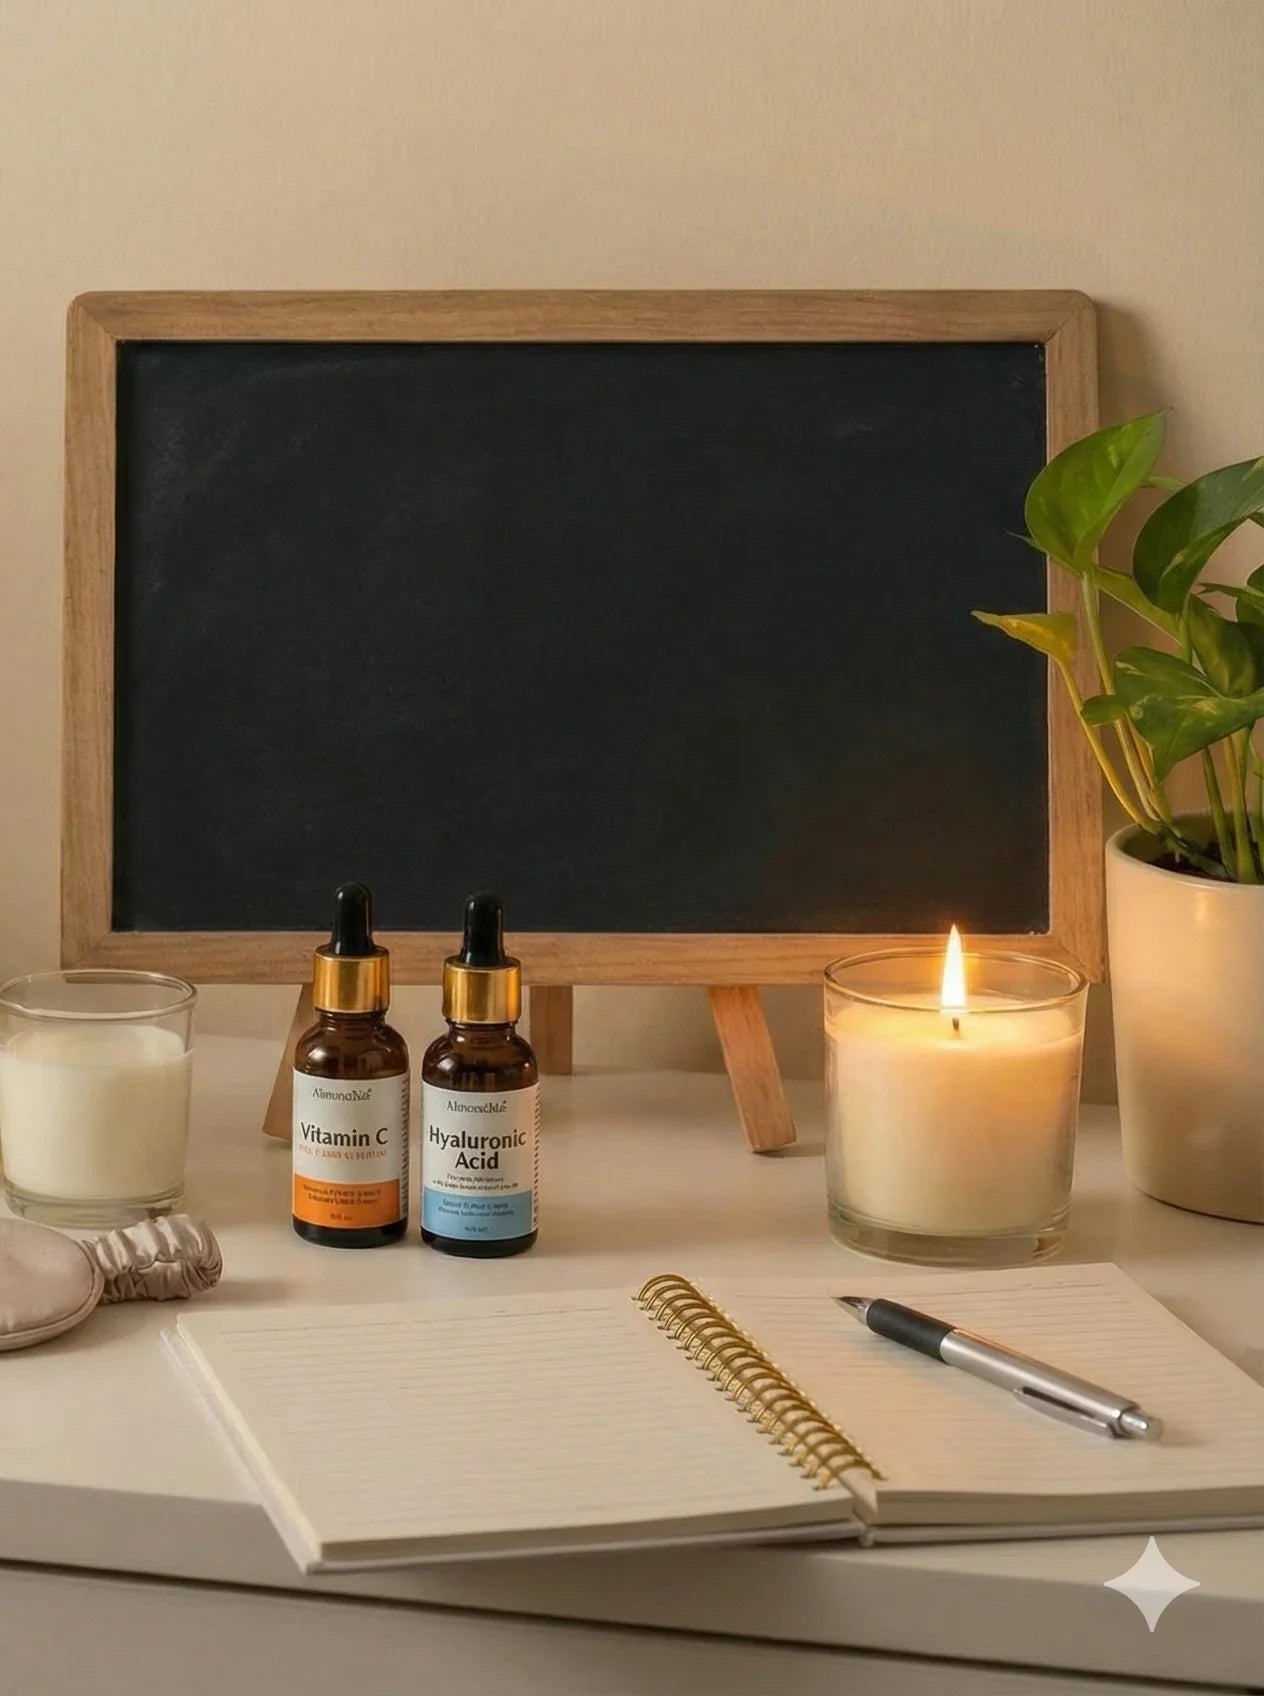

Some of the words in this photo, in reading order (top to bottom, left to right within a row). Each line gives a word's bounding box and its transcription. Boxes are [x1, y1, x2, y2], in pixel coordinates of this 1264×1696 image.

[300, 1122, 370, 1147] Vitamin
[376, 1128, 388, 1144] C
[429, 1125, 527, 1150] Hyaluronic
[455, 1151, 499, 1170] Acid
